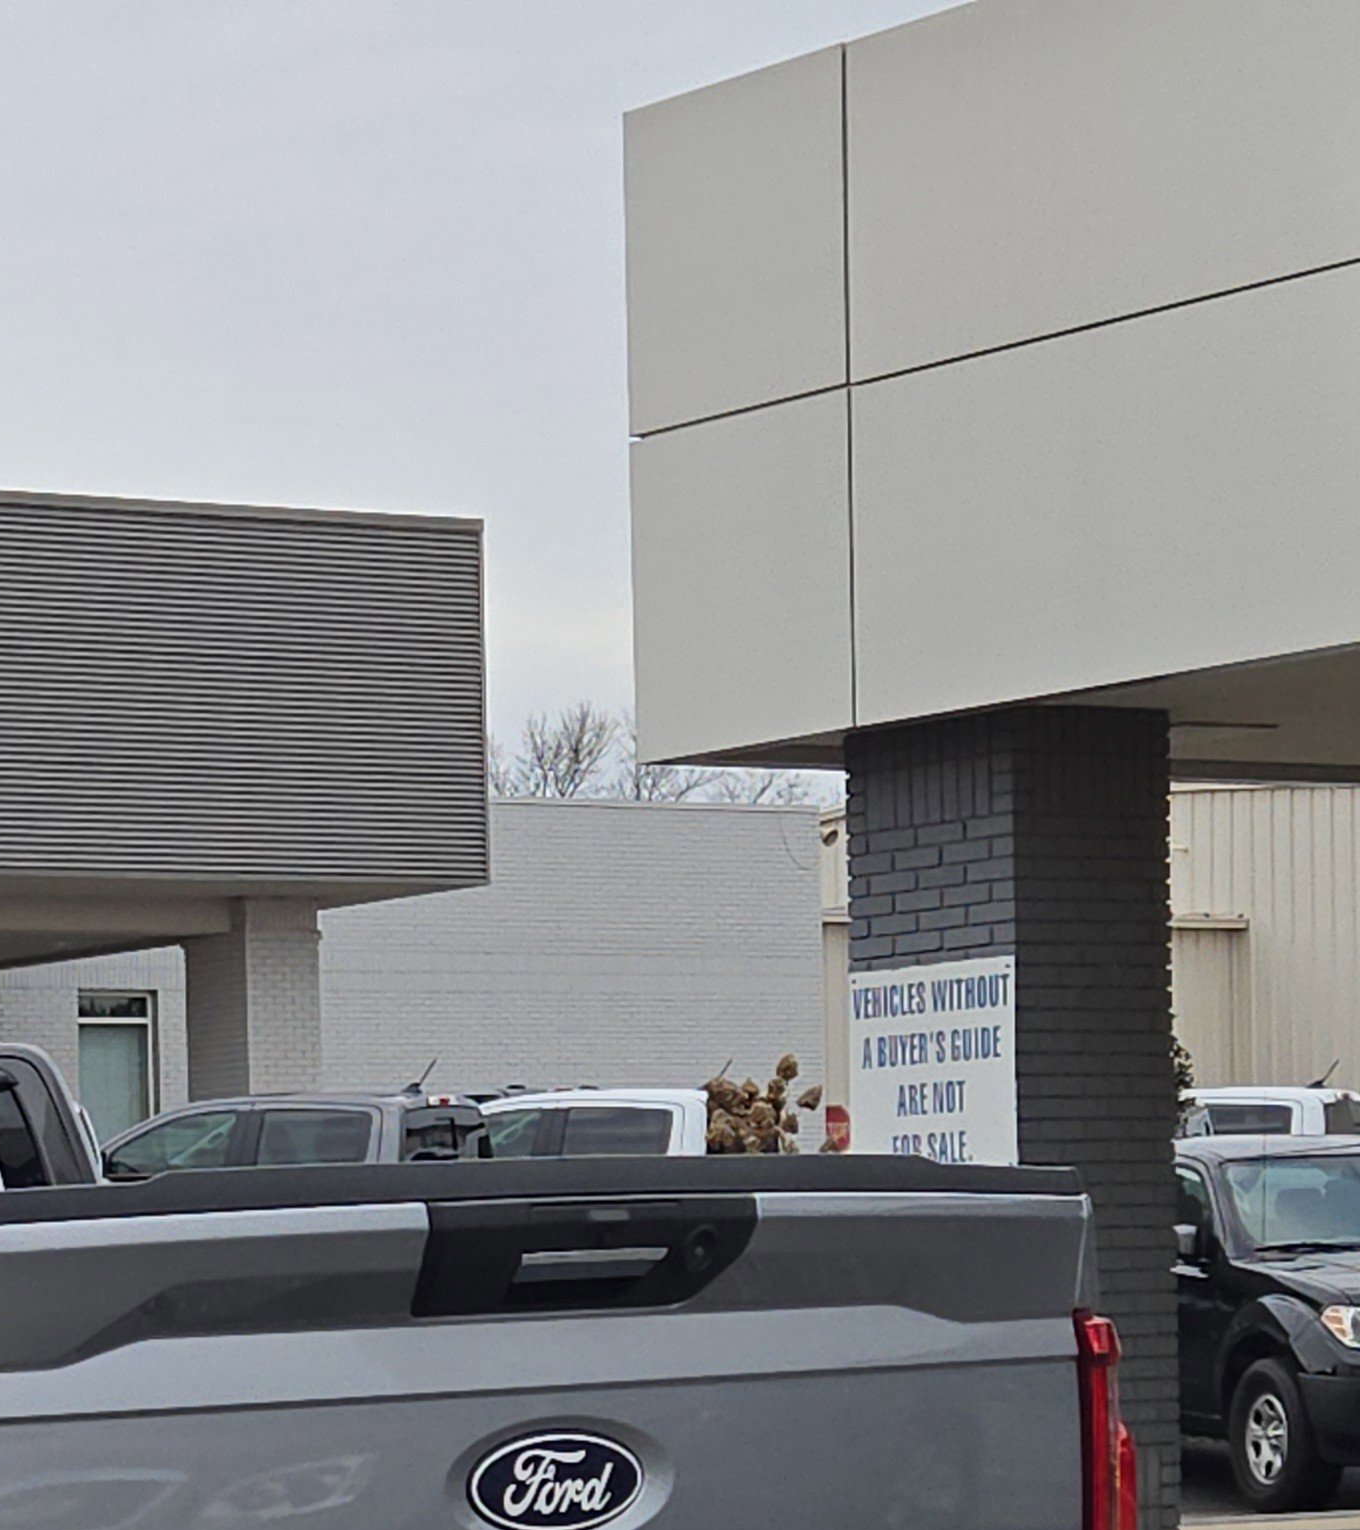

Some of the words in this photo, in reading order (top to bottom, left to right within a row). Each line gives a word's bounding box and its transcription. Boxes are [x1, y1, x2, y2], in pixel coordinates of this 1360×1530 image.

[852, 981, 926, 1020] VEHICLES
[931, 973, 1010, 1013] WITHOUT
[861, 1037, 873, 1069] A
[877, 1030, 946, 1068] BUYER'S
[950, 1025, 1002, 1062] GUIDE
[897, 1083, 928, 1117] ARE
[932, 1080, 966, 1114] NOT
[892, 1133, 922, 1156] FOR
[502, 1448, 613, 1518] Ford
